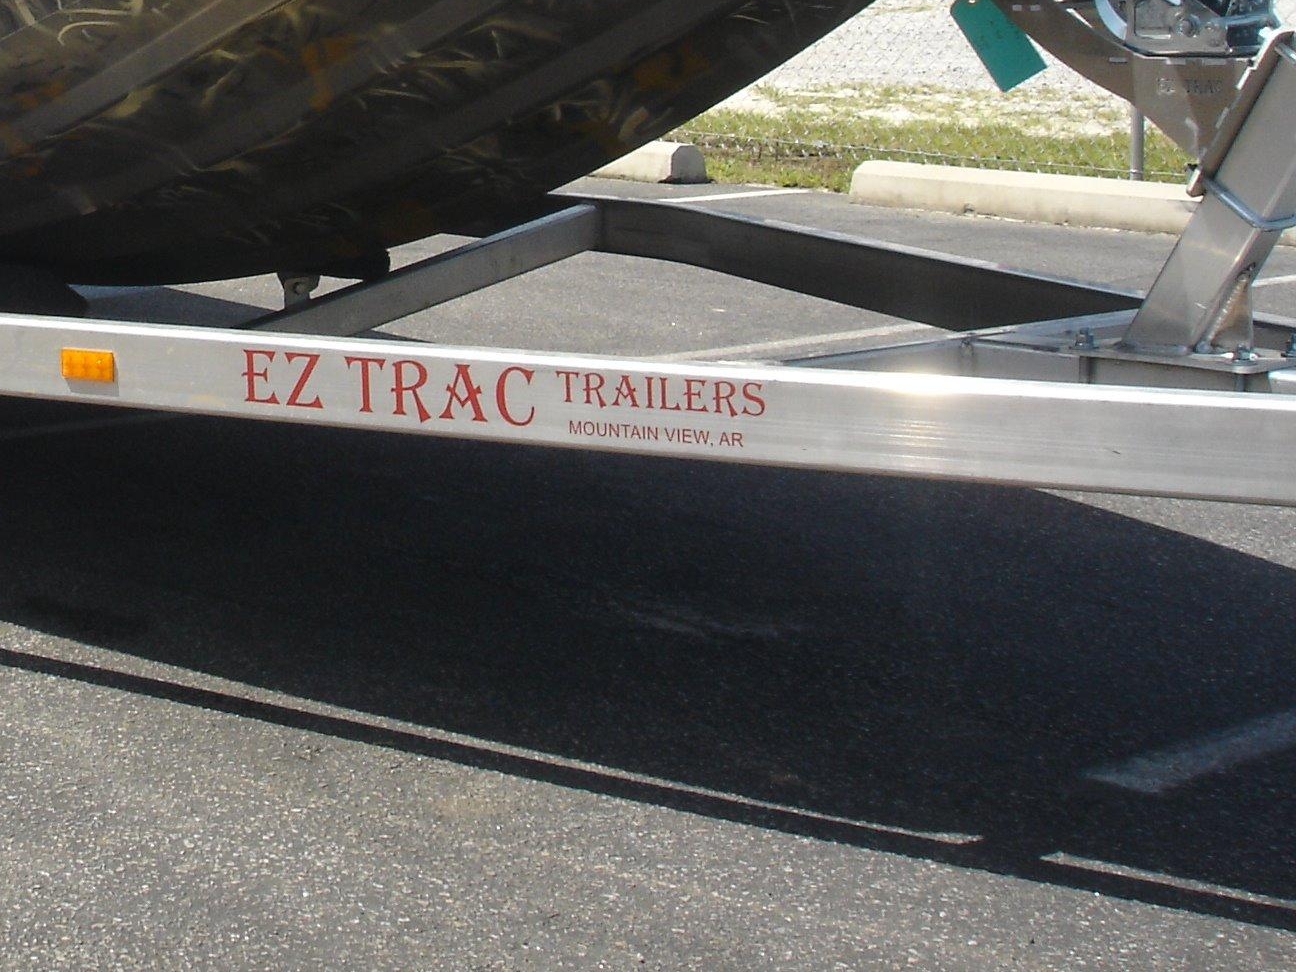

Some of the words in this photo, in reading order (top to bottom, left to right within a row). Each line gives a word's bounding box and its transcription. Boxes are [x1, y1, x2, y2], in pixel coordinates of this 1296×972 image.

[241, 349, 324, 410] EZ
[345, 355, 536, 427] TRAC
[555, 369, 766, 417] TRAILERS
[568, 419, 659, 443] MOUNTAIN
[664, 428, 714, 448] VIEW,
[719, 430, 744, 449] AR
